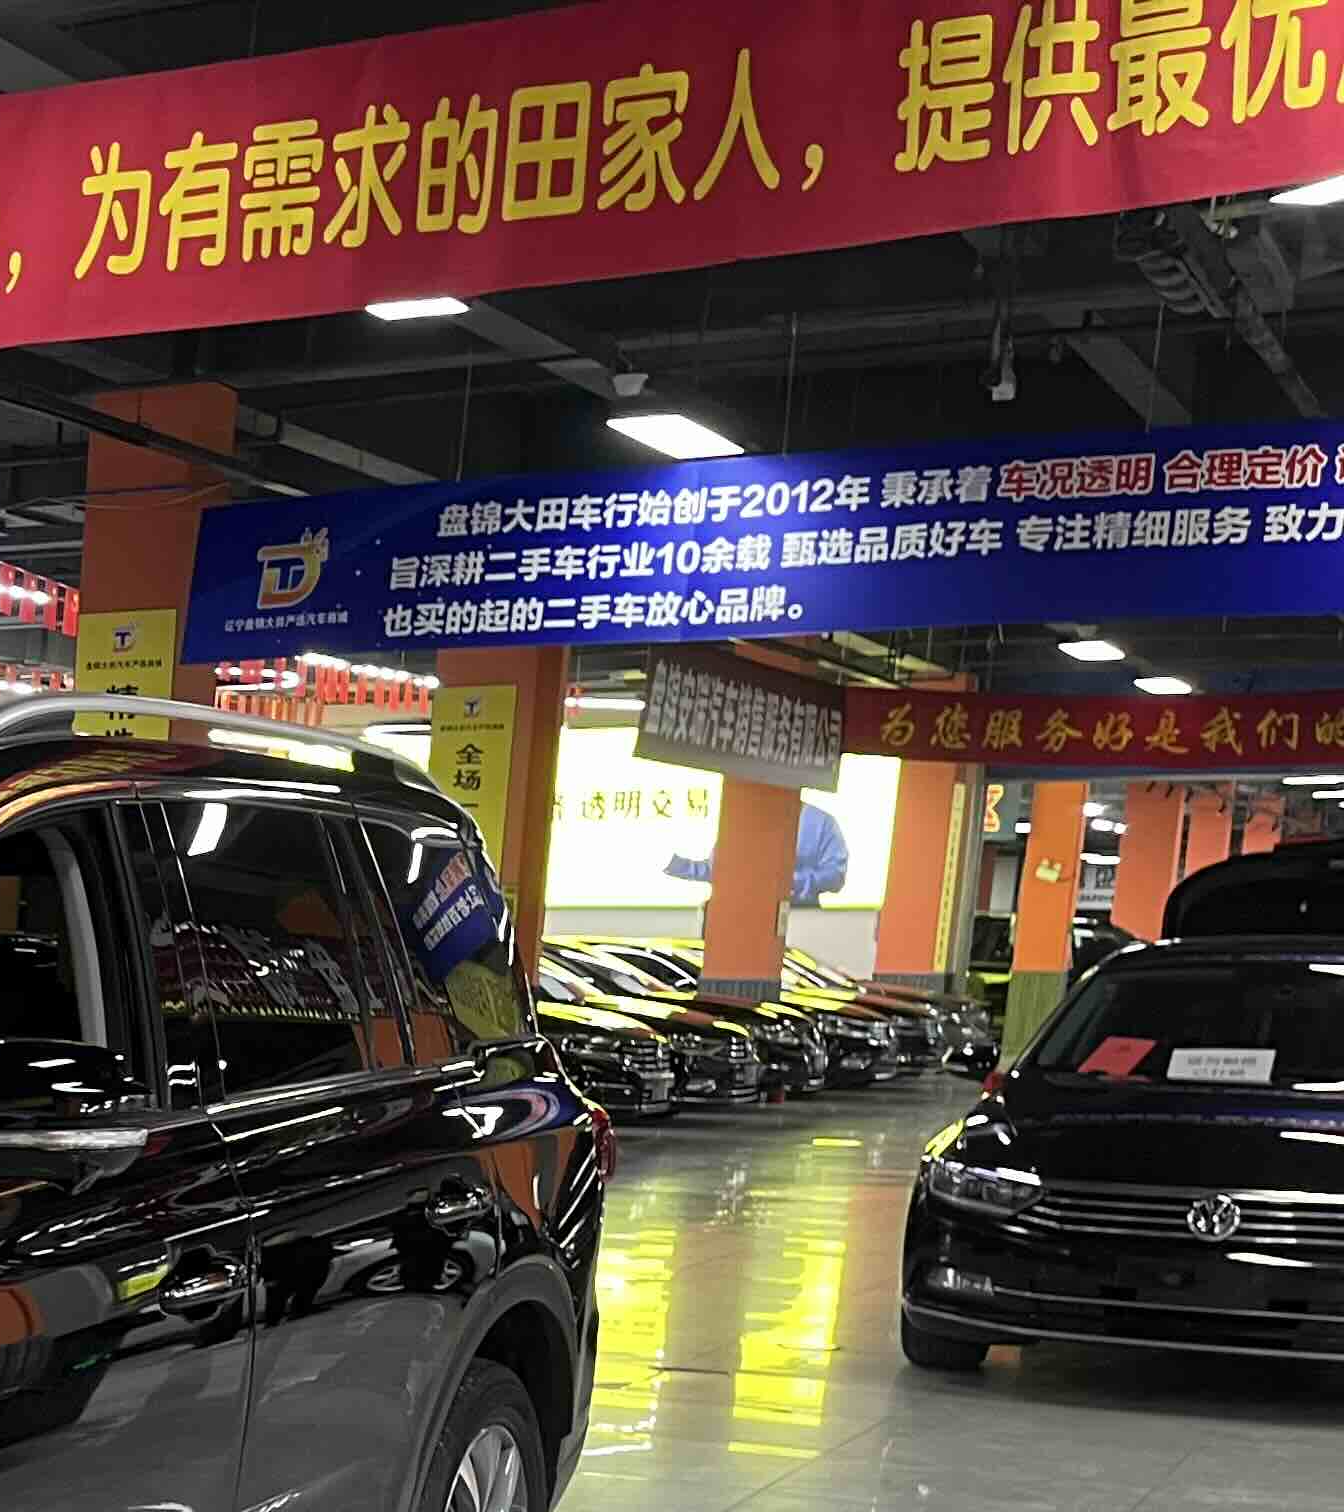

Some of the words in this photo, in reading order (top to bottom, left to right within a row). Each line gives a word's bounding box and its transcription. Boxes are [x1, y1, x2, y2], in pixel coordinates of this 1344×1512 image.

[437, 474, 871, 539] 盘锦大田车行始创于2012年
[997, 453, 1156, 501] 车况透明
[1164, 444, 1326, 492] 合理定价
[389, 534, 770, 592] 旨深耕二手车行业10余载
[780, 518, 1004, 569] 甄选品质好车
[1015, 505, 1252, 552] 专注精细服务
[1263, 501, 1344, 545] 致力
